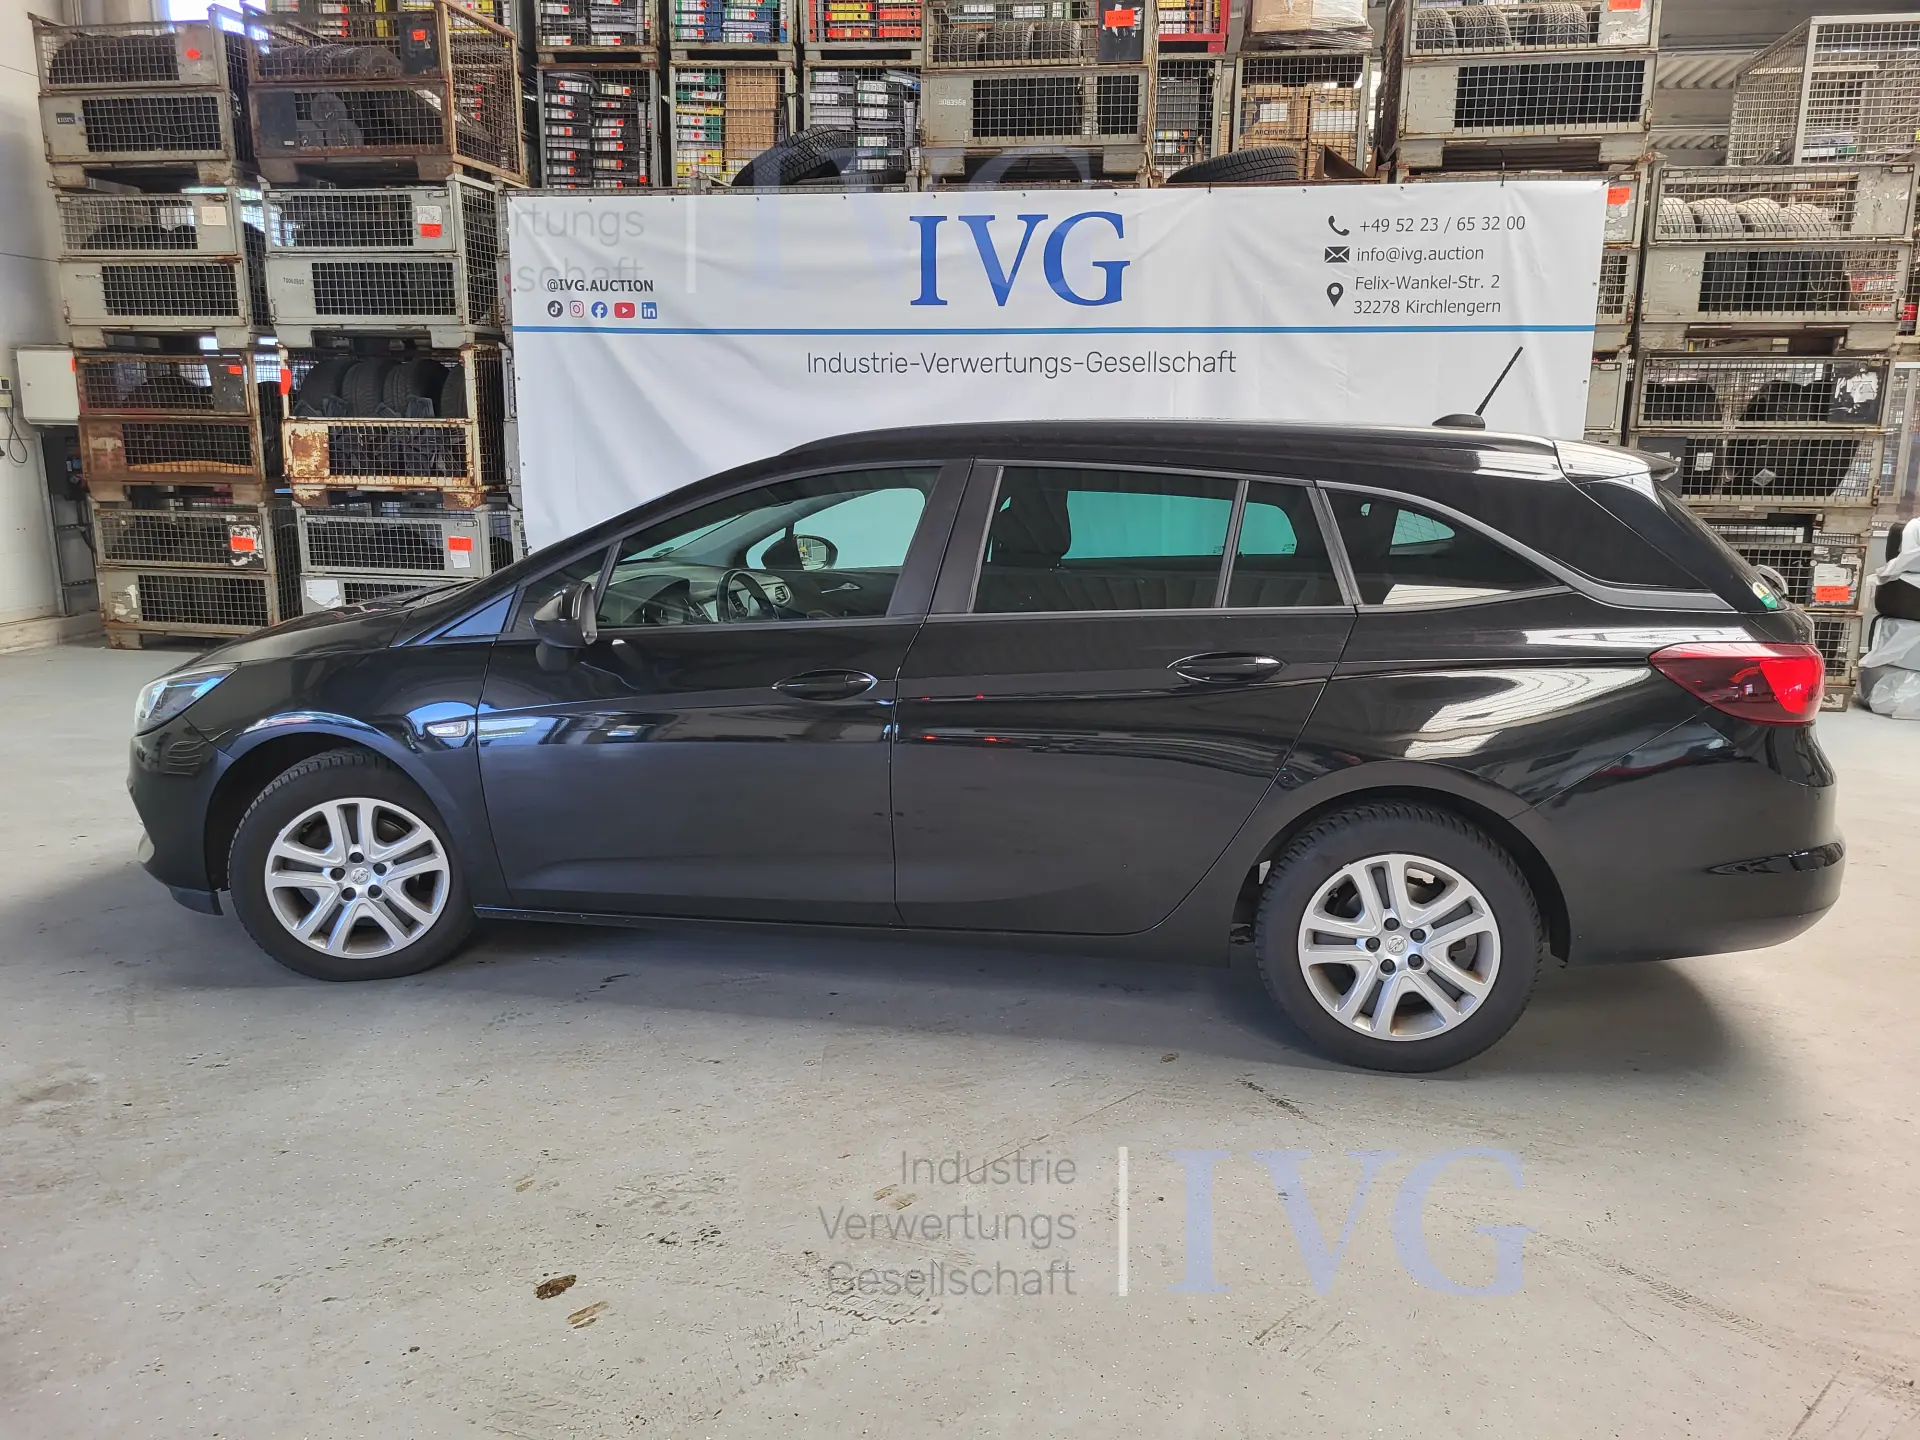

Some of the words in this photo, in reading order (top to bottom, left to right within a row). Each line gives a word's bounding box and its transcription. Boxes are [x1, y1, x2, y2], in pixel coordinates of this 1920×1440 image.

[1359, 218, 1390, 233] +49
[1395, 217, 1414, 232] 52
[1420, 217, 1439, 232] 23
[1456, 216, 1476, 231] 65
[1481, 216, 1500, 231] 32
[1506, 215, 1526, 230] 00
[909, 211, 1131, 307] IVG
[1356, 246, 1484, 264] info@ivg.auction
[546, 278, 654, 293] @IVG.AUCTION
[1355, 275, 1484, 290] Felix-Wankel-Str.
[1490, 274, 1500, 289] 2
[1353, 300, 1400, 314] 32278
[1405, 299, 1501, 316] Kirchlengern
[806, 350, 1237, 379] Industrie-Verwertungs-Gesellschaft
